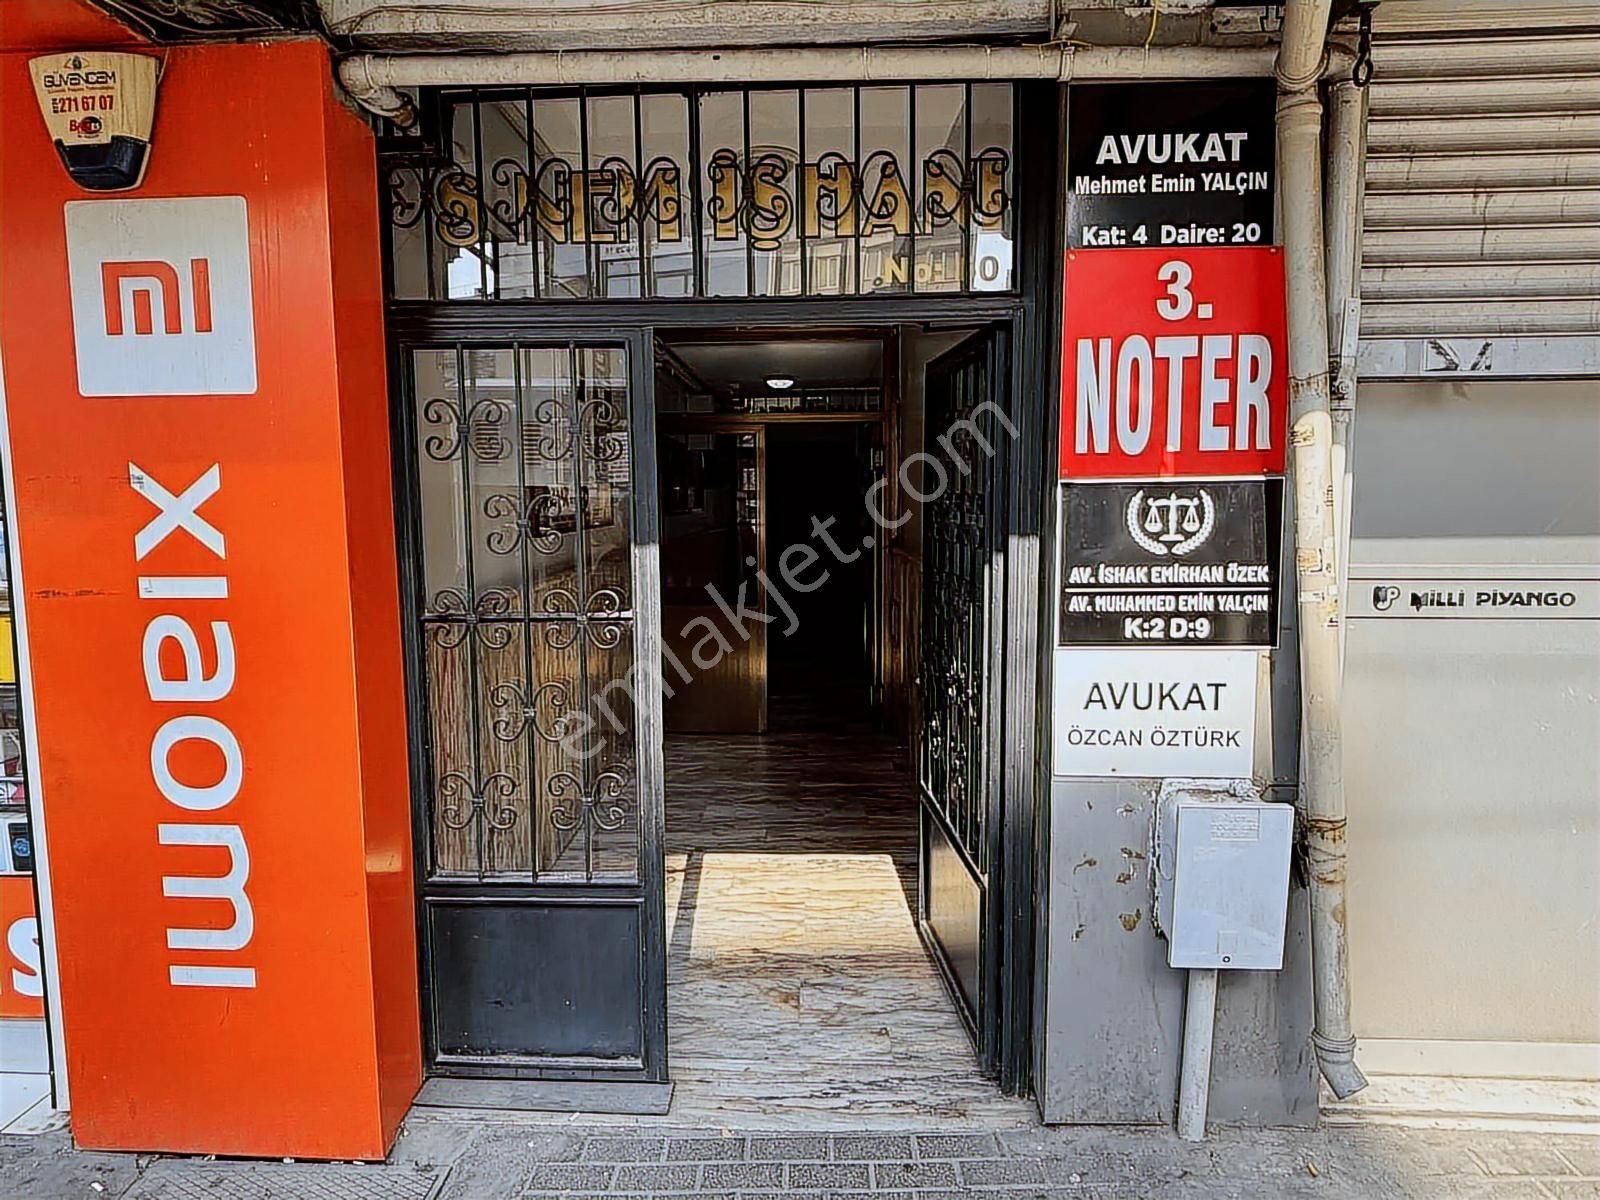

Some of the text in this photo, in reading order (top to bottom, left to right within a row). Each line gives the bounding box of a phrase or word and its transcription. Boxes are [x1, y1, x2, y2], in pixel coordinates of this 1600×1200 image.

[59, 96, 79, 113] 271
[81, 95, 96, 111] 67
[99, 94, 114, 110] 07
[1095, 132, 1248, 165] AVUKAT
[1075, 171, 1268, 195] Mehmet Emin YALÇIN
[1082, 222, 1261, 246] Kat: 4 Daire: 20
[1156, 260, 1213, 321] 3.
[1075, 334, 1272, 456] NOTER
[1068, 562, 1270, 584] AV. İSHAK EMİRHAN ÖZEK
[1068, 592, 1269, 614] AV. MUHAMMED EMİN YALÇIN
[1124, 617, 1211, 639] K:2 D:9
[1083, 682, 1227, 711] AVUKAT
[128, 461, 257, 989] xiaomi
[1067, 724, 1241, 748] ÖZCAN ÖZTÜRK
